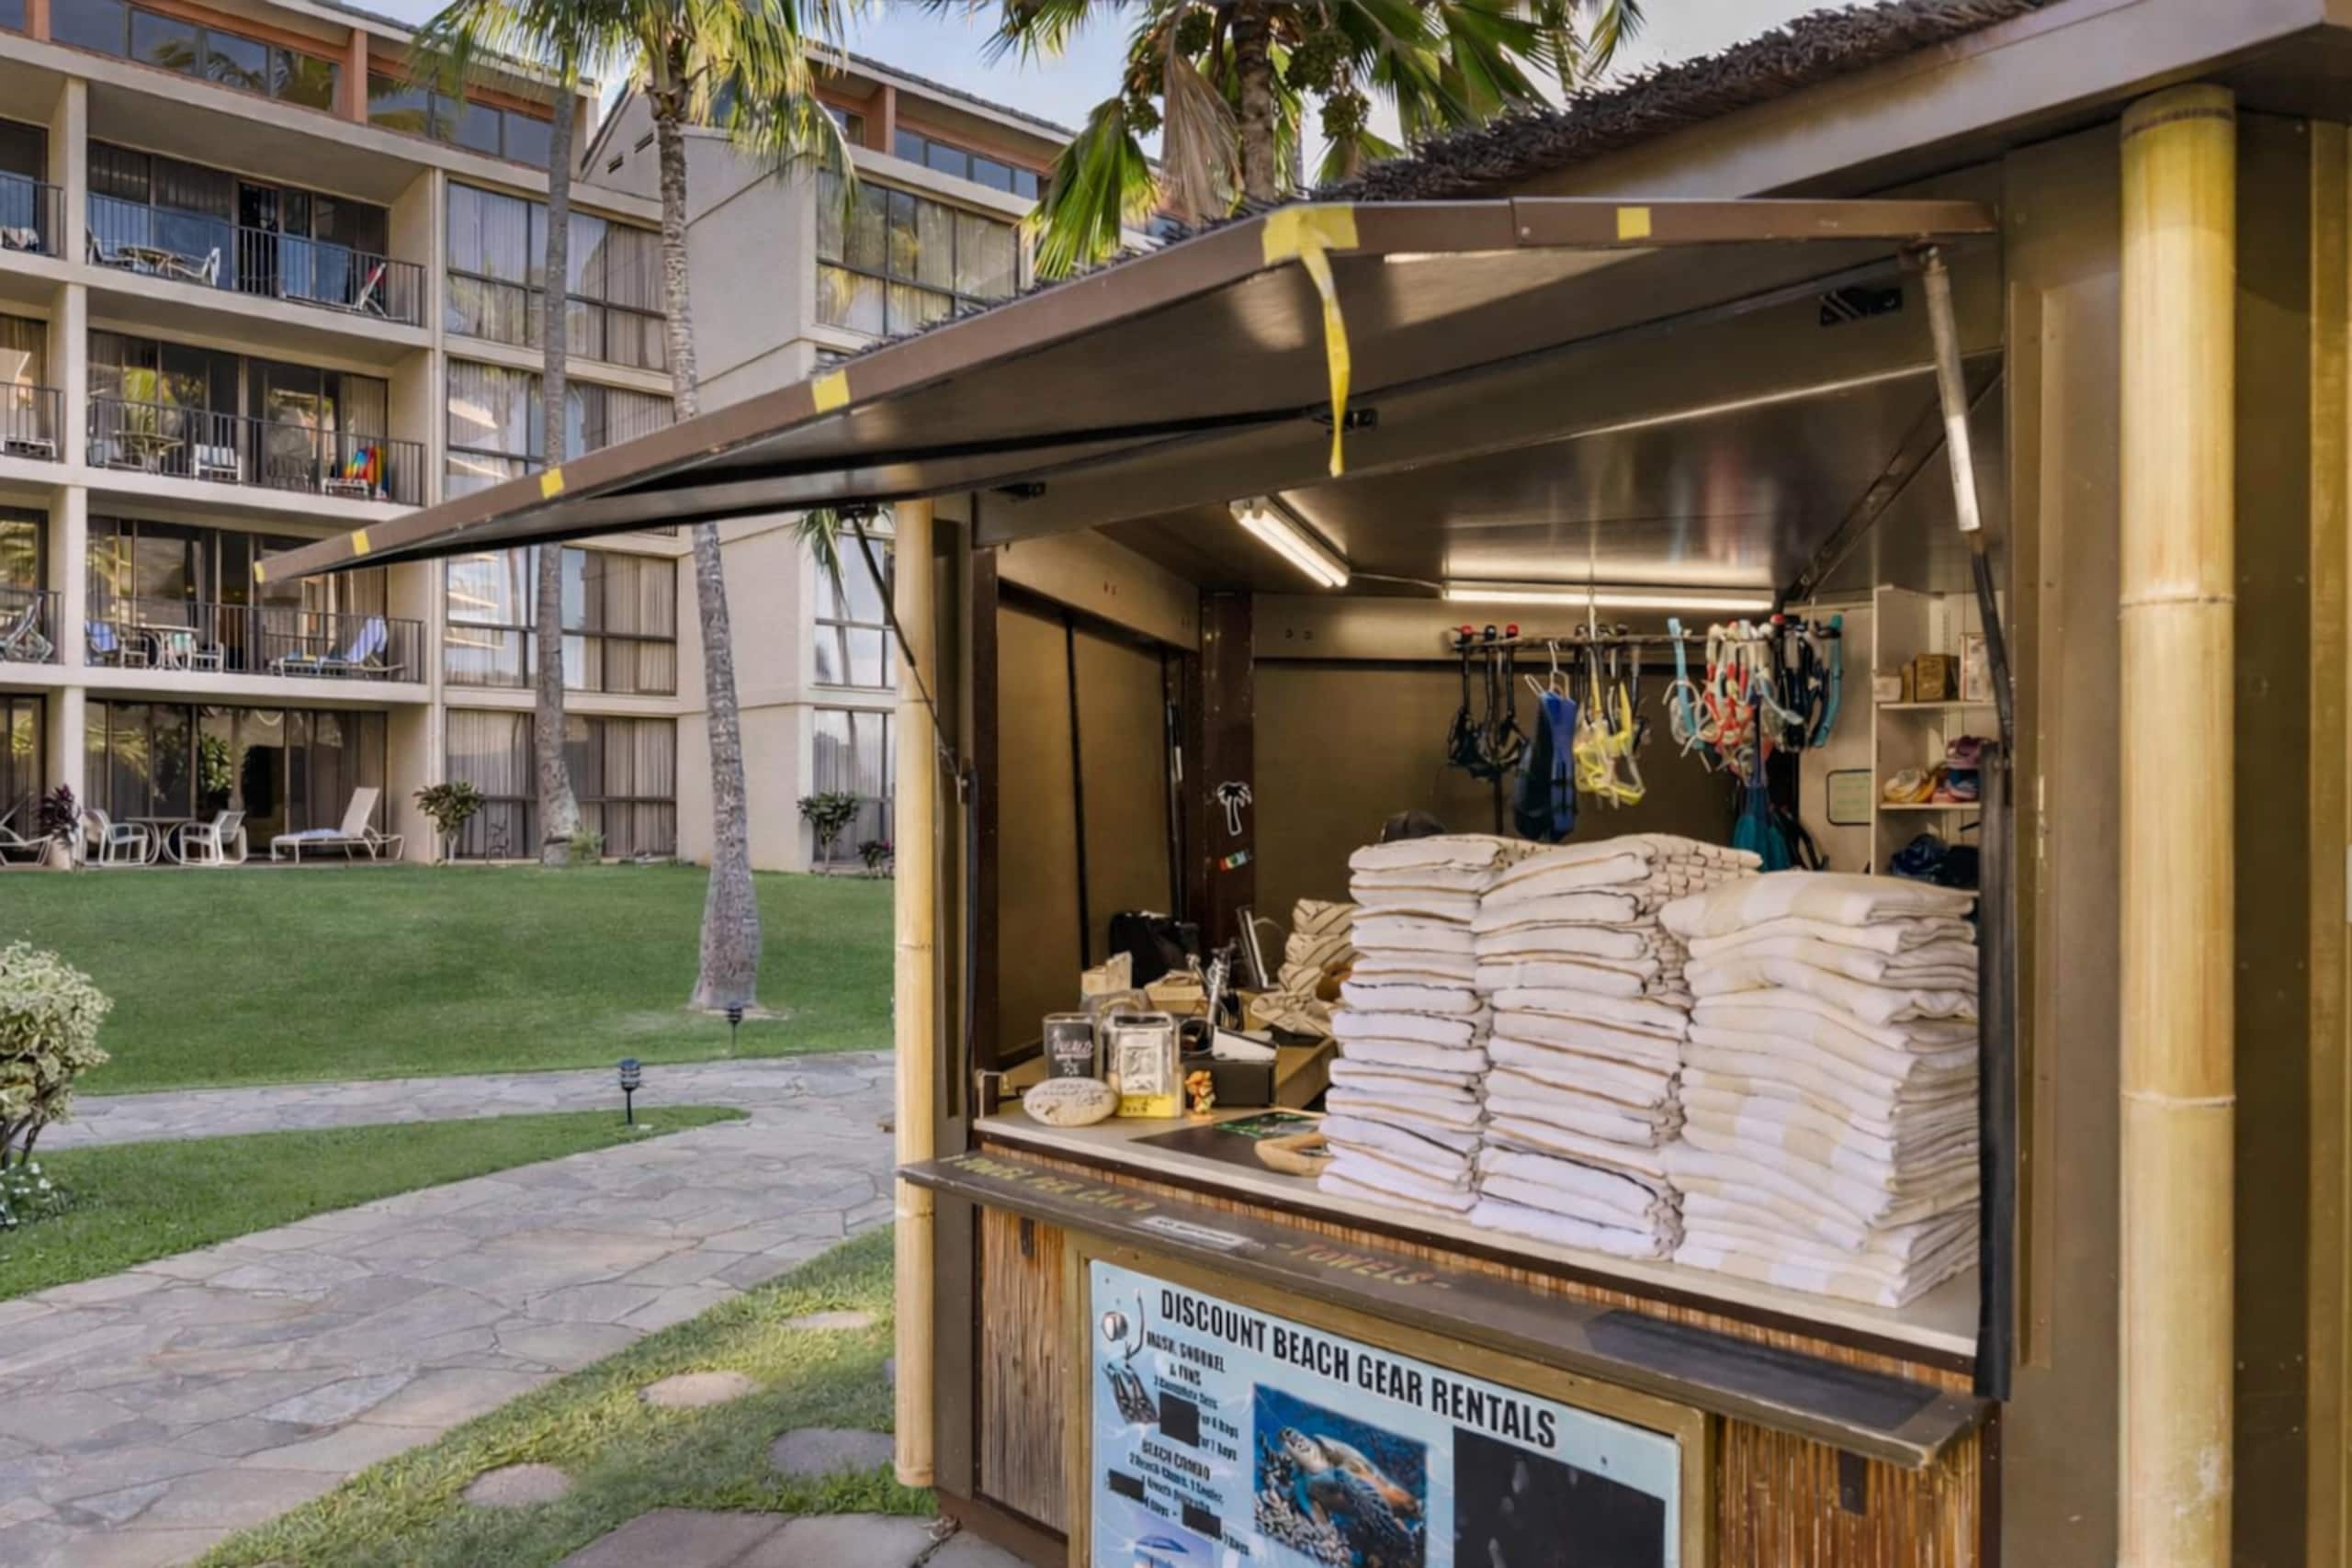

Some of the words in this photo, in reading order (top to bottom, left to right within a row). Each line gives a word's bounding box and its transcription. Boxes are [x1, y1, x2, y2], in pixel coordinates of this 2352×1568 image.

[1289, 1242, 1435, 1286] TOWELS
[1161, 1289, 1267, 1353] DISCOUNT
[1273, 1325, 1350, 1383] BEACH
[1357, 1354, 1423, 1407] GEAR
[1431, 1377, 1556, 1450] RENTALS
[1179, 1366, 1202, 1387] FINS
[1142, 1439, 1171, 1463] BEACH
[1175, 1452, 1210, 1481] COMBO
